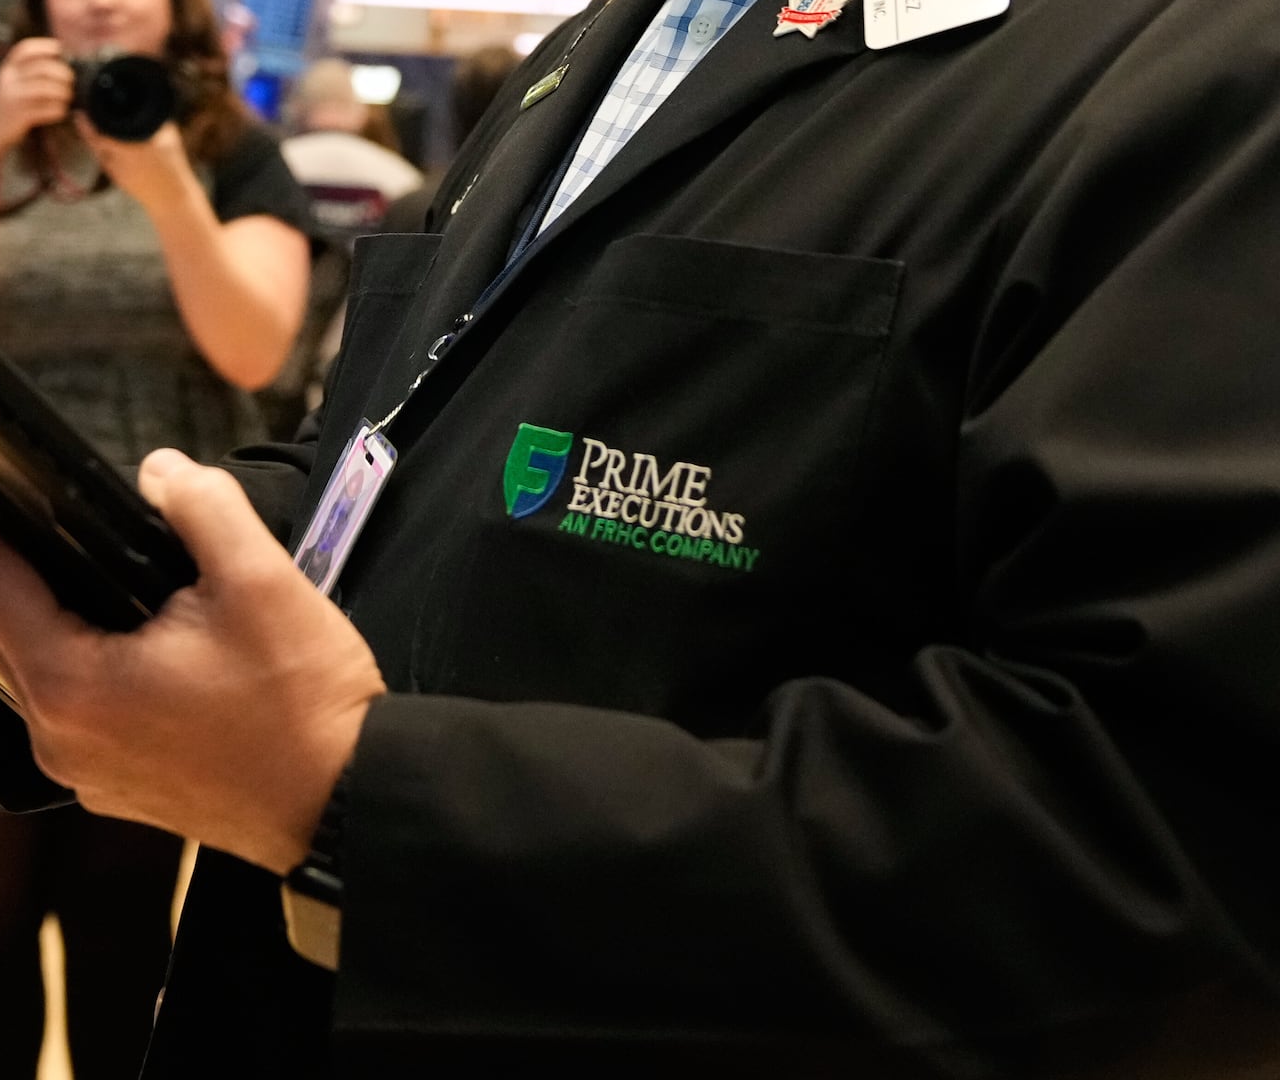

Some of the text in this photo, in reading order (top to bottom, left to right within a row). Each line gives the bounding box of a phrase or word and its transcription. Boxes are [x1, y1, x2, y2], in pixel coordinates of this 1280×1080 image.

[573, 437, 712, 507] PRIME
[558, 512, 761, 571] AN FRHC COMPANY
[567, 483, 746, 545] EXECUTIONS
